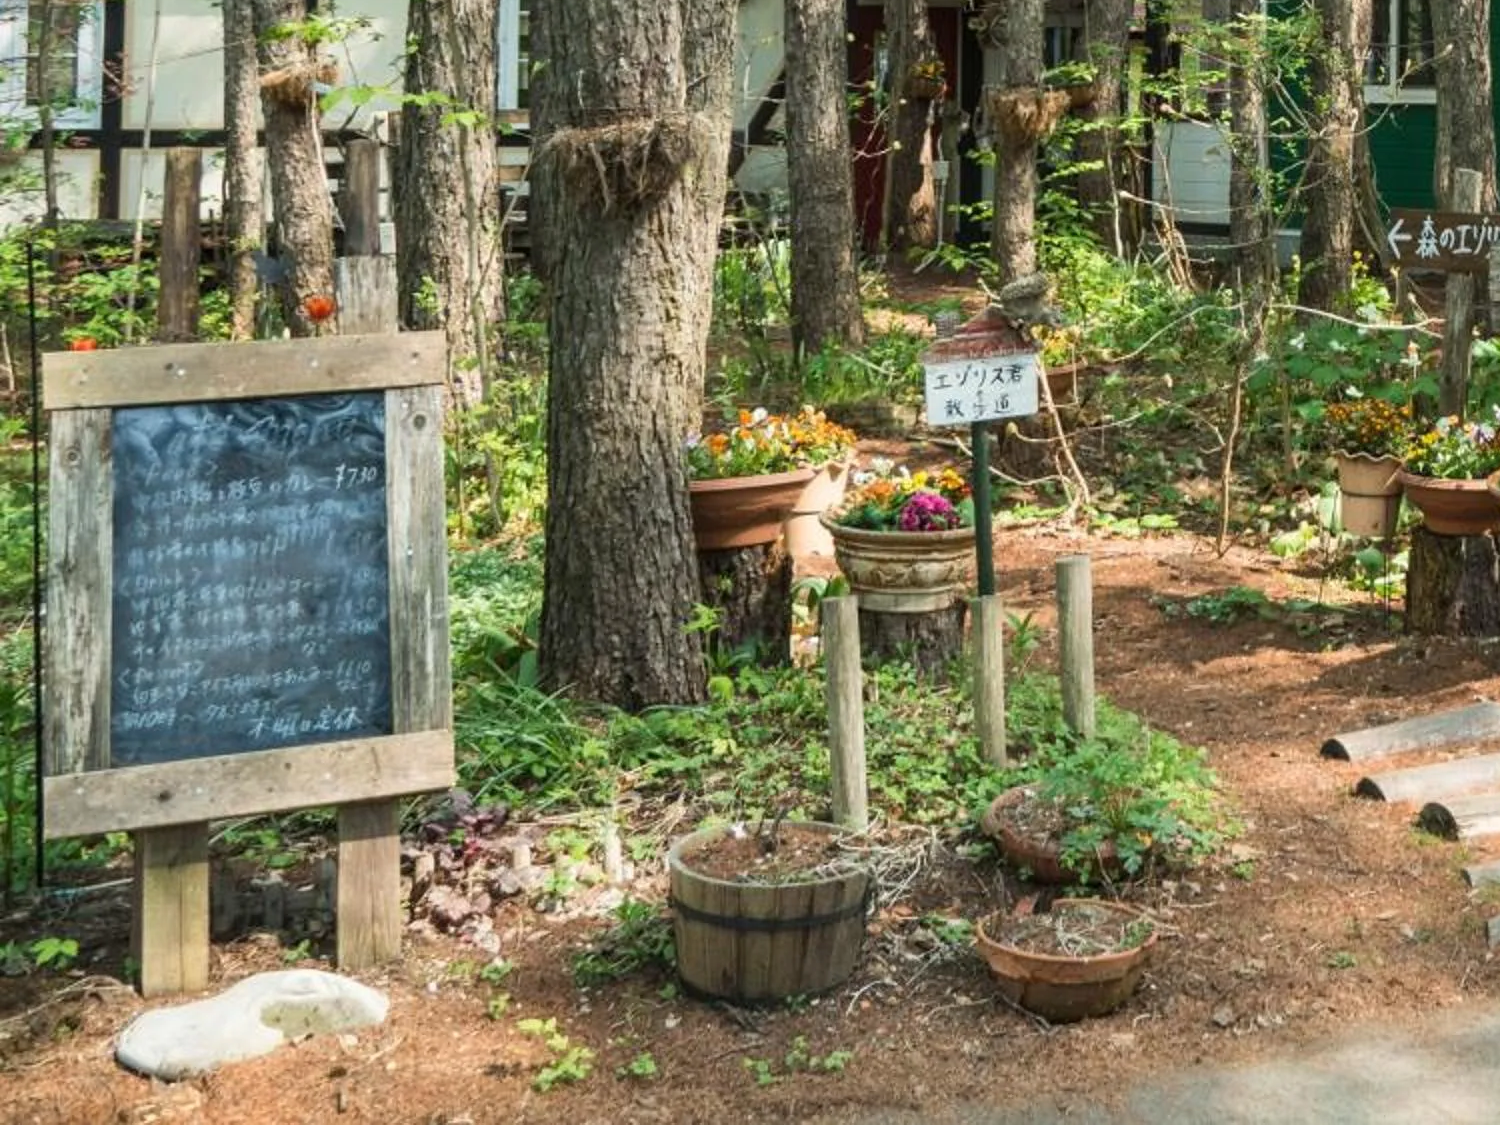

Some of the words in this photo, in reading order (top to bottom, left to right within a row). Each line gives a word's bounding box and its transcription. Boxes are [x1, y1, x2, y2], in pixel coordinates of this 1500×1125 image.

[933, 361, 1026, 391] エゾリス君
